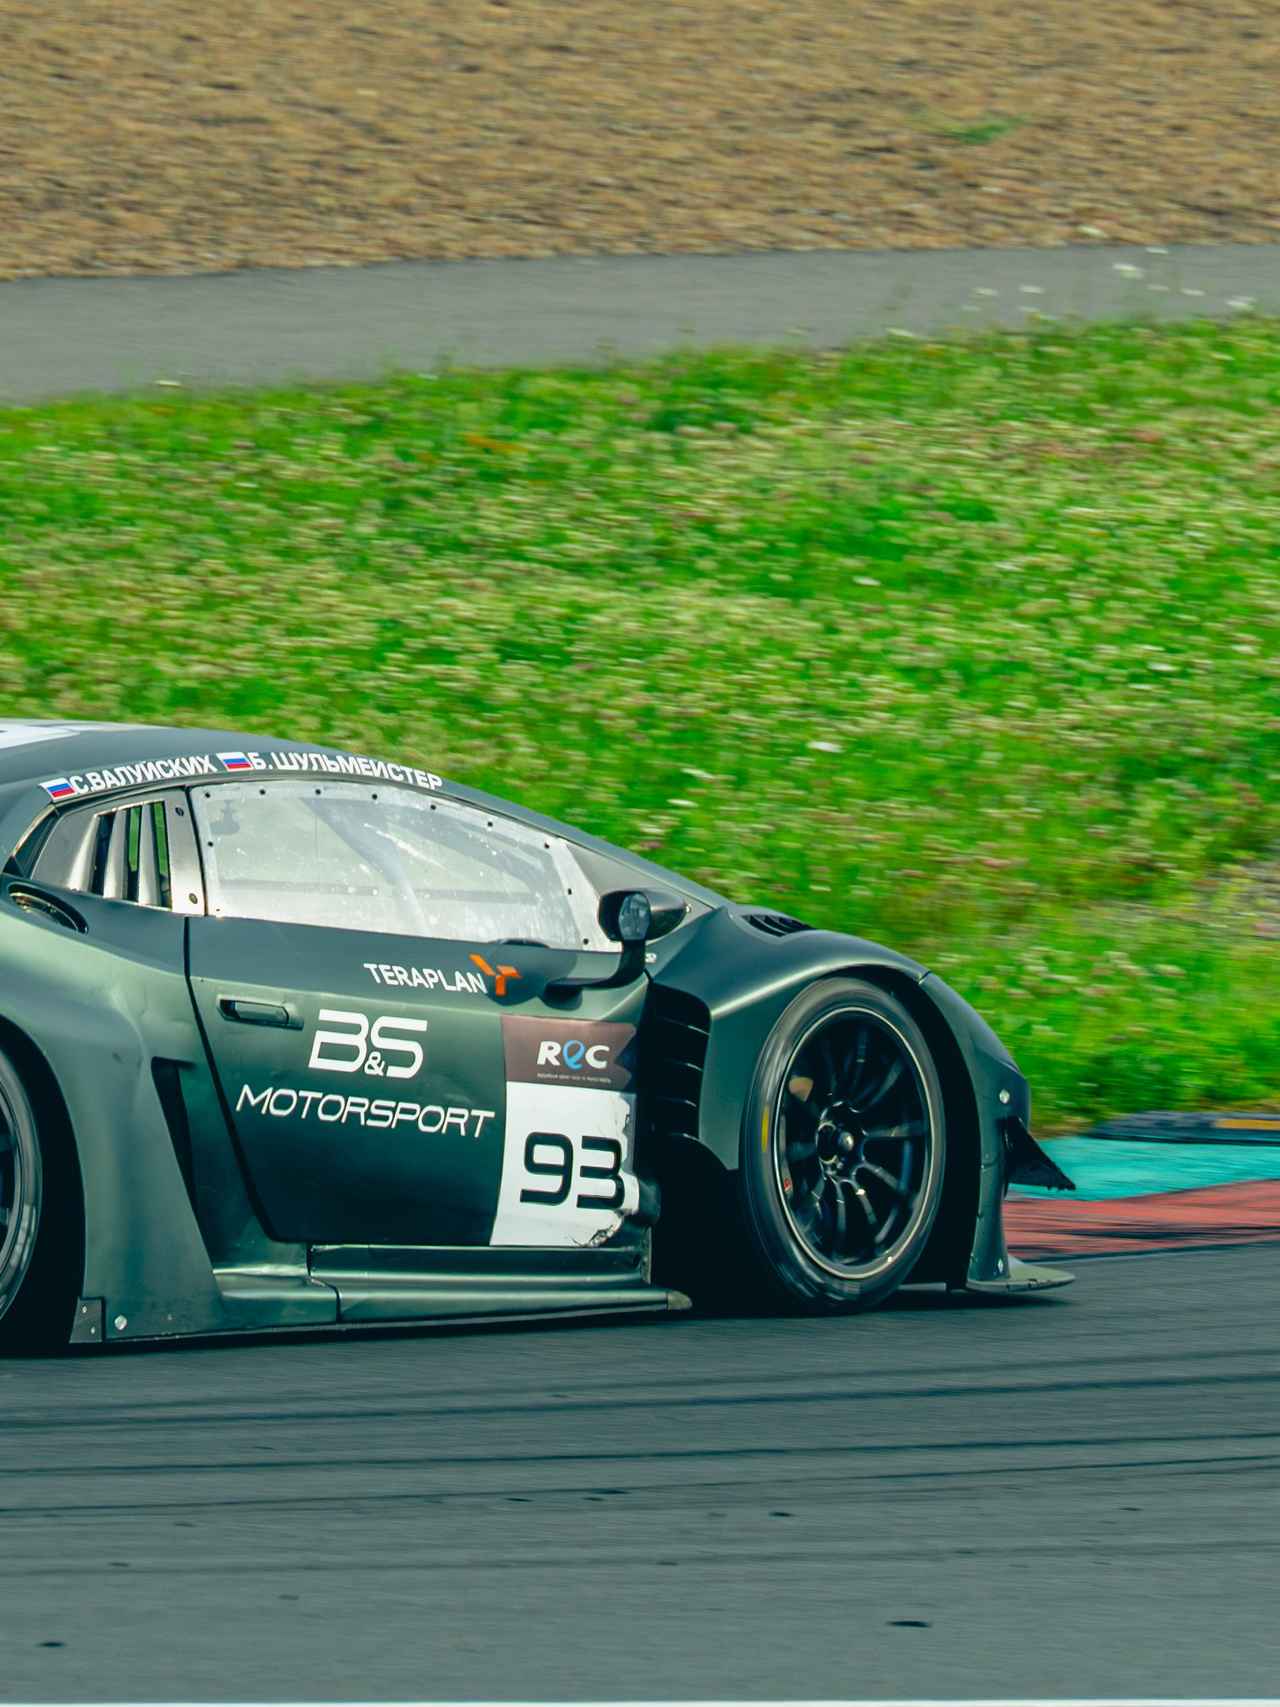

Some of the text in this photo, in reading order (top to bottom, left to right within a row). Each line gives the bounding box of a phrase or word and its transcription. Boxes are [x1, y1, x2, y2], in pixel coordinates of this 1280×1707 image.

[70, 754, 218, 794] С.ВАЛУЙСКИХ
[363, 963, 488, 994] TERAPLAN
[308, 1008, 429, 1079] B&S
[235, 1083, 496, 1139] MOTORSPORT
[519, 1131, 626, 1211] 93
